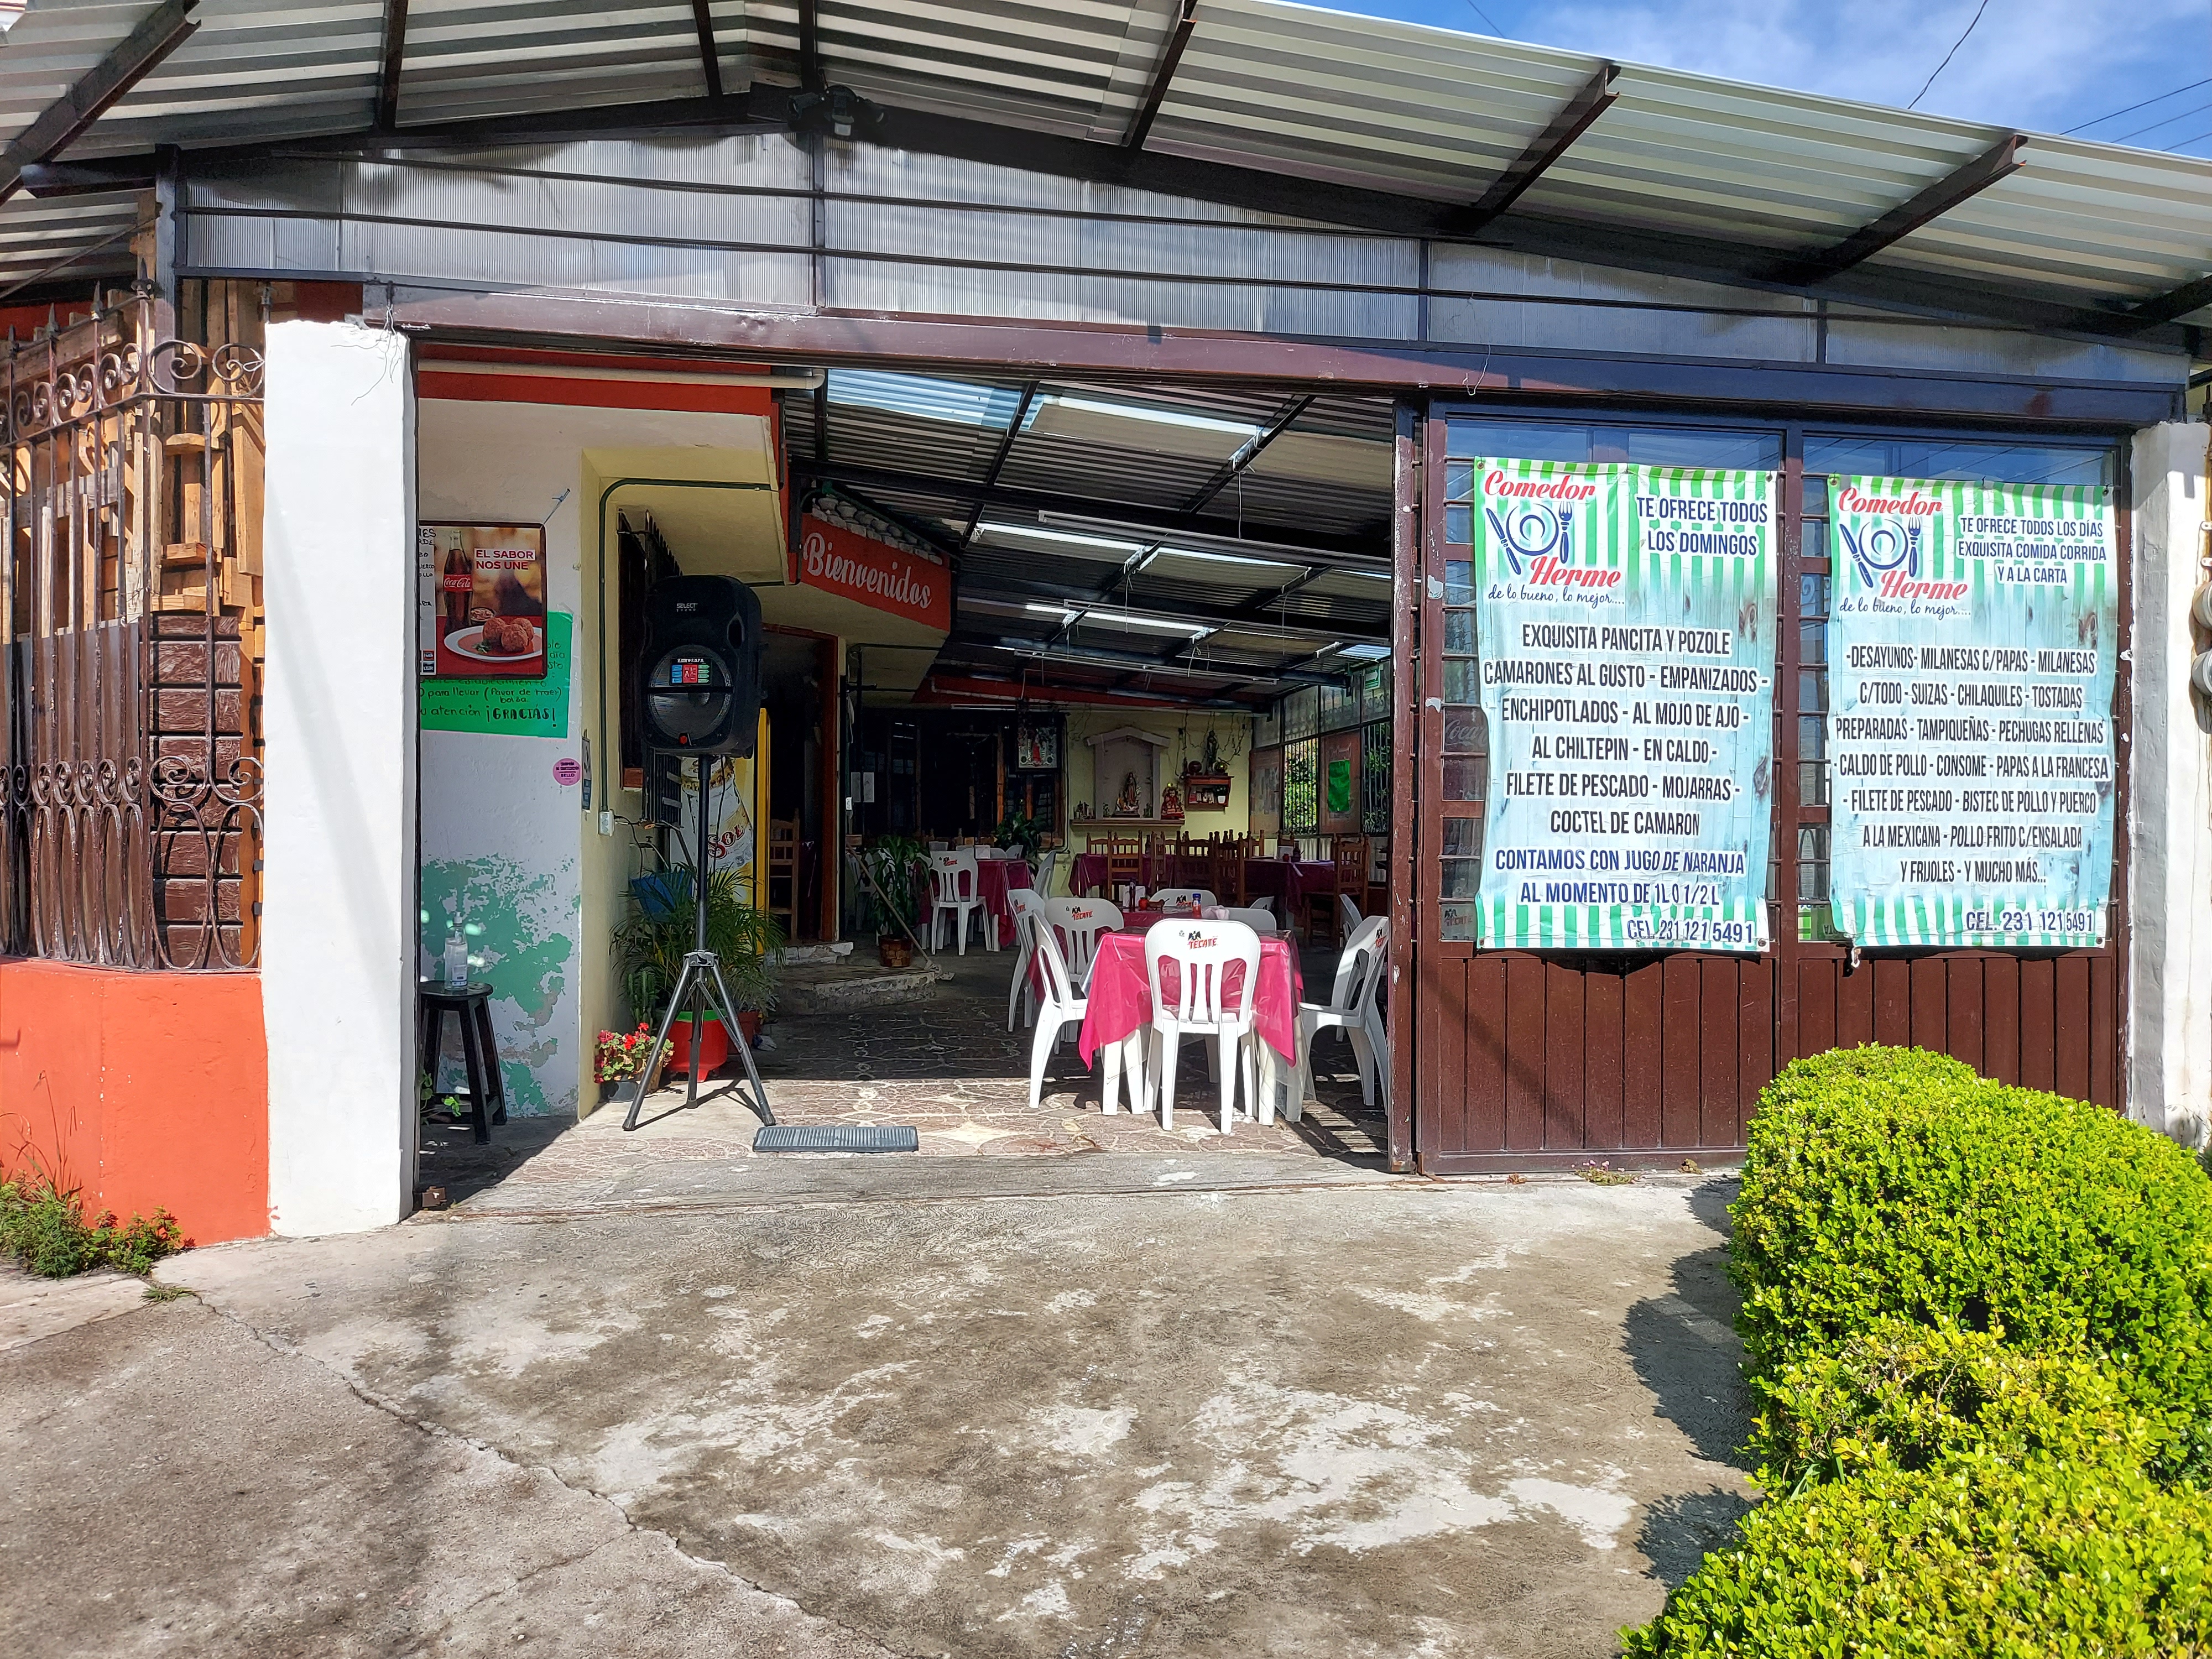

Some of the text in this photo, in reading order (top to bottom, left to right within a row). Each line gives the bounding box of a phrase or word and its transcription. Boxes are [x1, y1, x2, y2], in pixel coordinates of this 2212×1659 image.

[1485, 471, 1595, 499] Comedor
[1636, 497, 1767, 523] TE OFRECE TODOS
[1839, 488, 1942, 515] Comedor
[1960, 518, 2103, 538] TE OFRECE TODOS LOS DÍAS
[493, 550, 534, 559] SABOR
[1648, 530, 1757, 556] LOS DOMINGOS
[1959, 541, 2106, 560] EXQUISITA COMIDA CORRIDA
[476, 561, 529, 570] NOS UNE
[803, 533, 932, 609] Bienvenidos
[1531, 556, 1621, 587] Herme
[1997, 566, 2067, 584] Y A LA CARTA
[1488, 584, 1505, 599] de
[1507, 583, 1516, 599] lo
[1562, 586, 1573, 603] lo
[1880, 570, 1968, 600] Herme
[1839, 598, 1855, 612] de
[1858, 598, 1868, 612] lo
[1911, 600, 1921, 614] lo
[1522, 624, 1730, 655] EXQUISITA PANCITA Y POZOLE
[1921, 648, 1980, 671] MILANESAS
[1983, 649, 2028, 672] C/PAPAS
[2038, 651, 2095, 674] MILANESAS
[1484, 660, 1757, 692] CAMARONES AL GUSTO EMPANIZADOS
[427, 691, 450, 699] para
[452, 687, 479, 696] llevar
[1860, 682, 2082, 708] C/TODO SUIZAS CHILAQUILES TOSTADAS
[431, 704, 481, 716] atención
[1502, 698, 1739, 728] ENCHIPOTLADOS AL MOJO DE AJO
[1836, 716, 2103, 744] PREPARADAS TAMPIQUEÑAS PECHUGAS RELLENAS
[1532, 736, 1708, 763] AL CHILTEPIN EN CALDO
[1840, 754, 2109, 779] CALDO DE POLLO CONSOME PAPAS A LA FRANCESA
[1506, 773, 1731, 801] FILETE DE PESCADO MOJARRAS
[1851, 790, 2096, 813] FILETE DE PESCADO BISTEC DE POLLO Y PUERCO
[1551, 810, 1699, 836] COCTEL DE CAMARON
[1863, 825, 2081, 848] A LA MEXICANA POLLO FRITO C/ENSALADA
[1496, 849, 1744, 874] CONTAMOS CON JUGO DE NARANJA
[1900, 861, 1907, 882] Y
[1910, 860, 1954, 883] FRIJOLES
[1964, 860, 1971, 882] Y
[1975, 861, 2012, 883] MUCHO
[1521, 883, 1541, 902] AL
[1546, 883, 1629, 903] MOMENTO
[1634, 883, 1651, 903] DE
[1072, 909, 1093, 921] TECATE
[2002, 912, 2032, 931] 231
[2042, 911, 2063, 931] 121
[2066, 912, 2091, 932] 5491
[1187, 932, 1218, 950] TECATE
[1658, 920, 1679, 940] 231
[1684, 921, 1707, 941] 121
[1713, 922, 1752, 943] 5491
